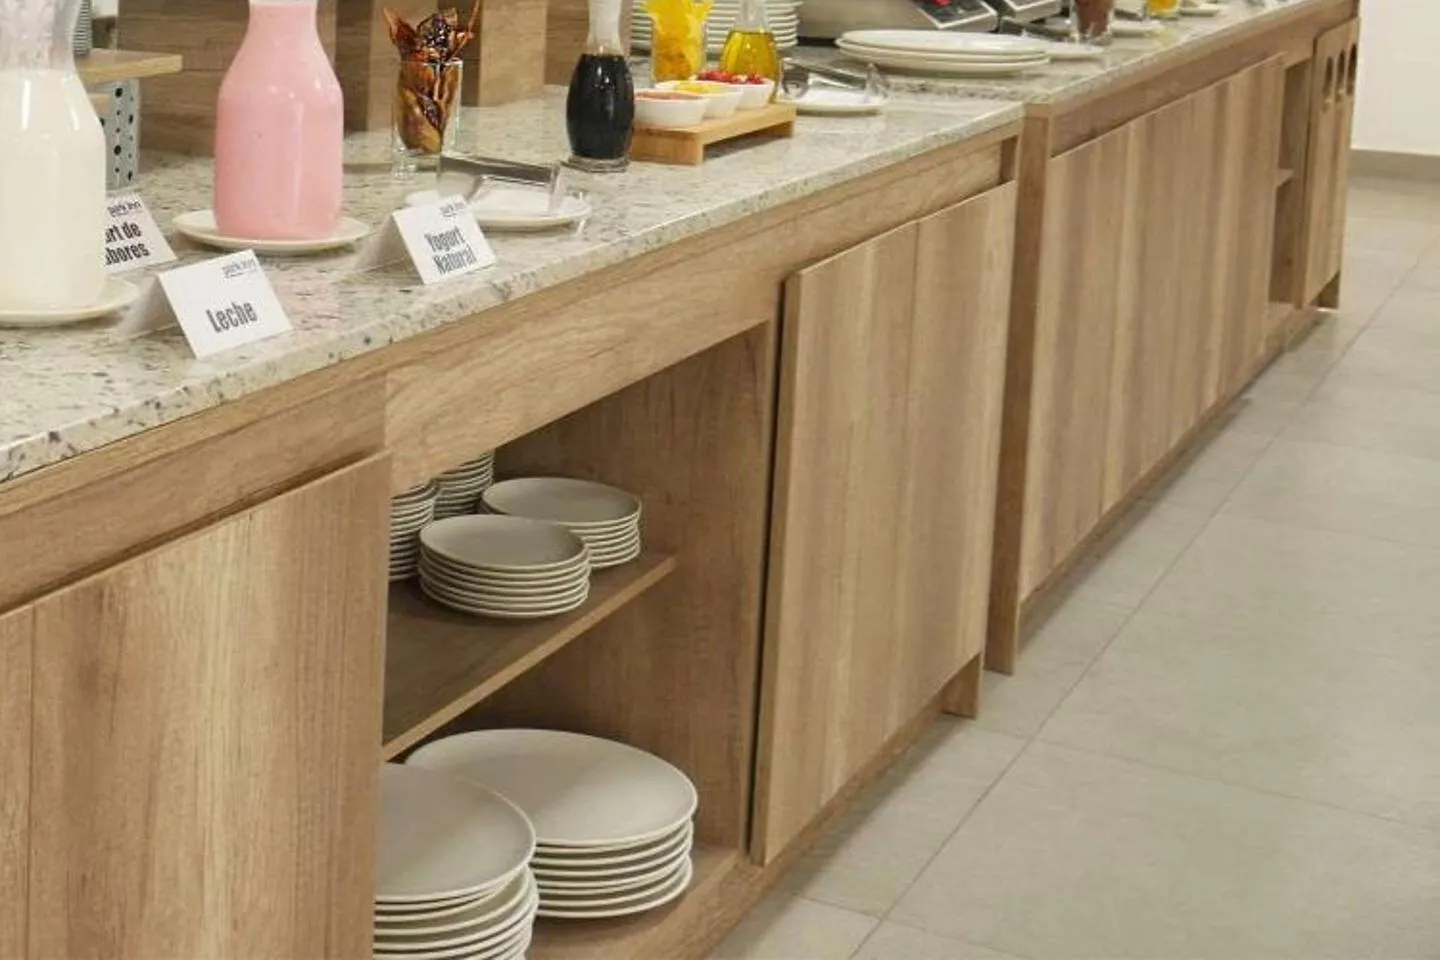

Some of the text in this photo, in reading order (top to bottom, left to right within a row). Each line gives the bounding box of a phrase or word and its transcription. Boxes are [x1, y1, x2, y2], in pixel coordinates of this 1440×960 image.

[121, 221, 141, 239] de
[105, 243, 149, 265] bores
[432, 243, 477, 275] Natural
[206, 302, 258, 333] Leche
